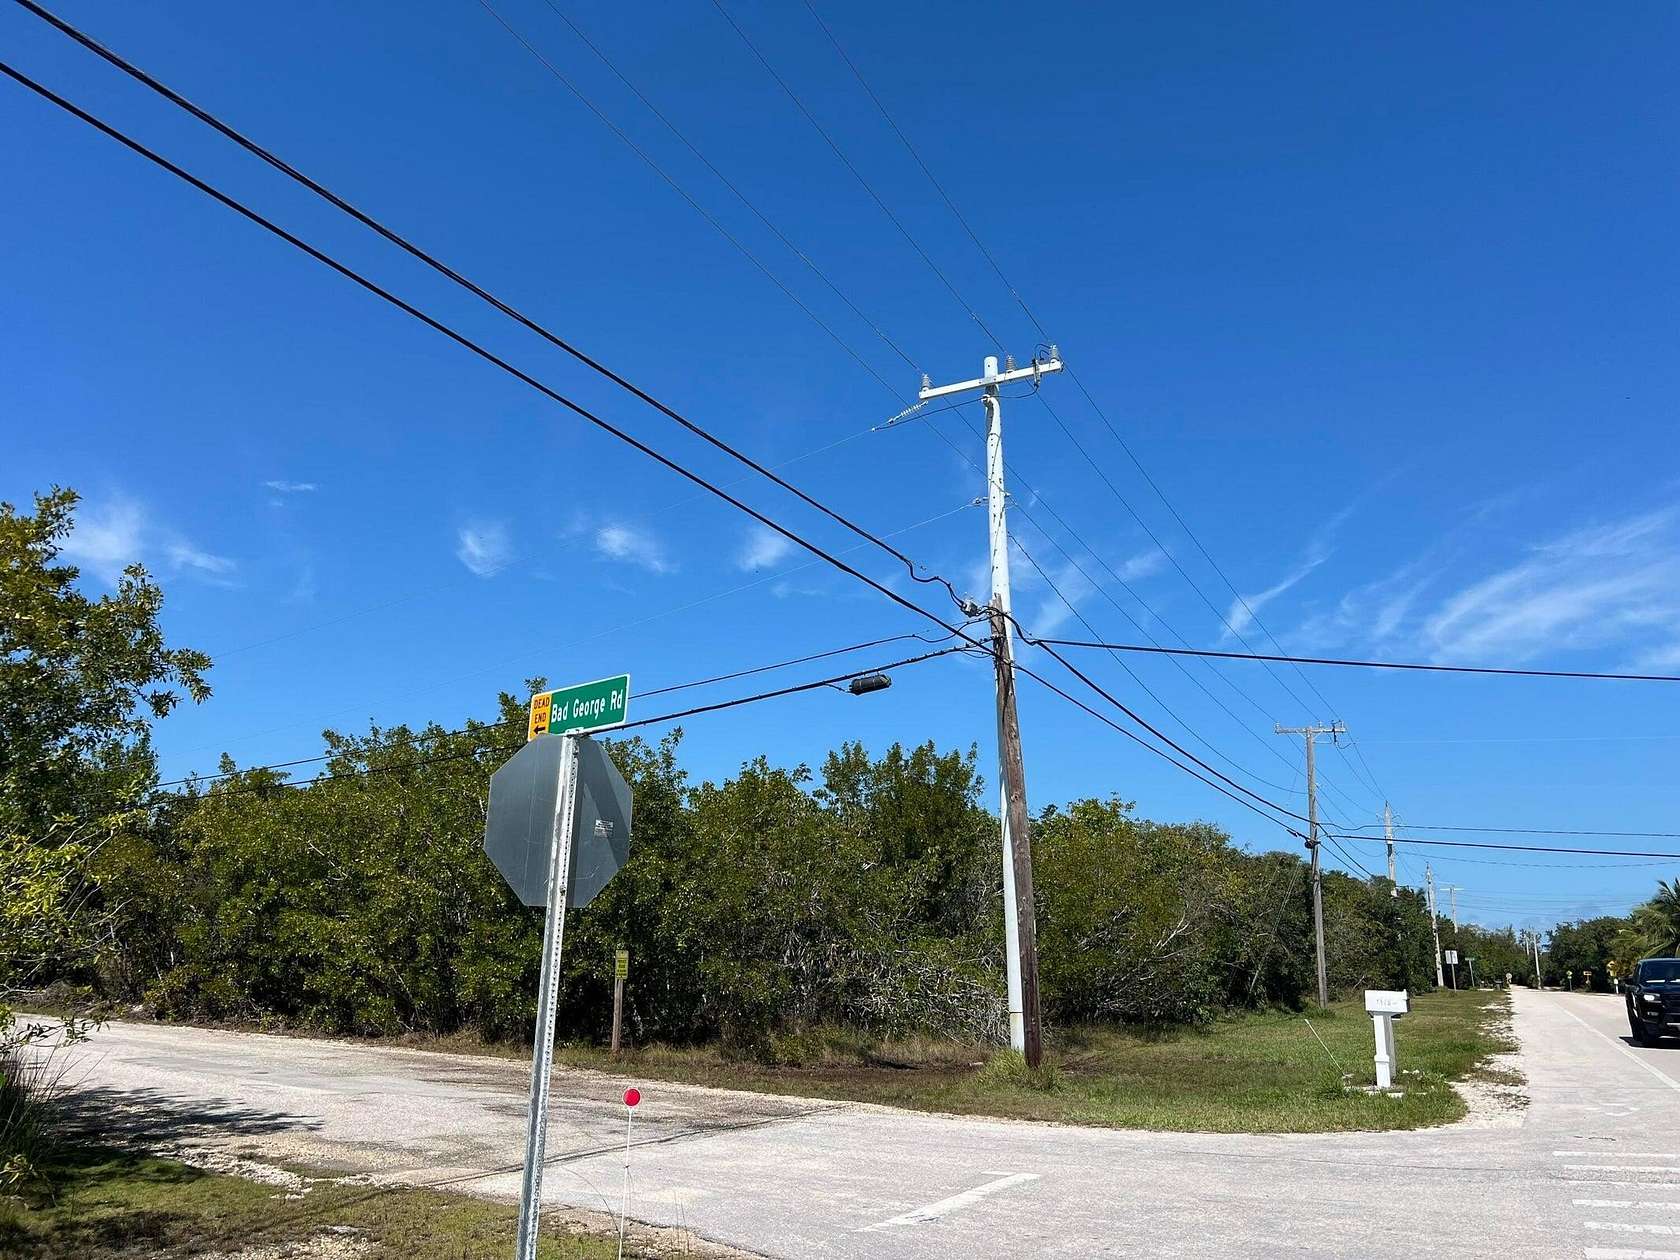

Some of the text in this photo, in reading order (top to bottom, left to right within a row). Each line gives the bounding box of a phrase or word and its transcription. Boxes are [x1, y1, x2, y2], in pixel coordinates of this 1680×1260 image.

[533, 697, 550, 710] DEAD
[551, 689, 623, 723] Bad George Rd
[534, 712, 547, 723] END
